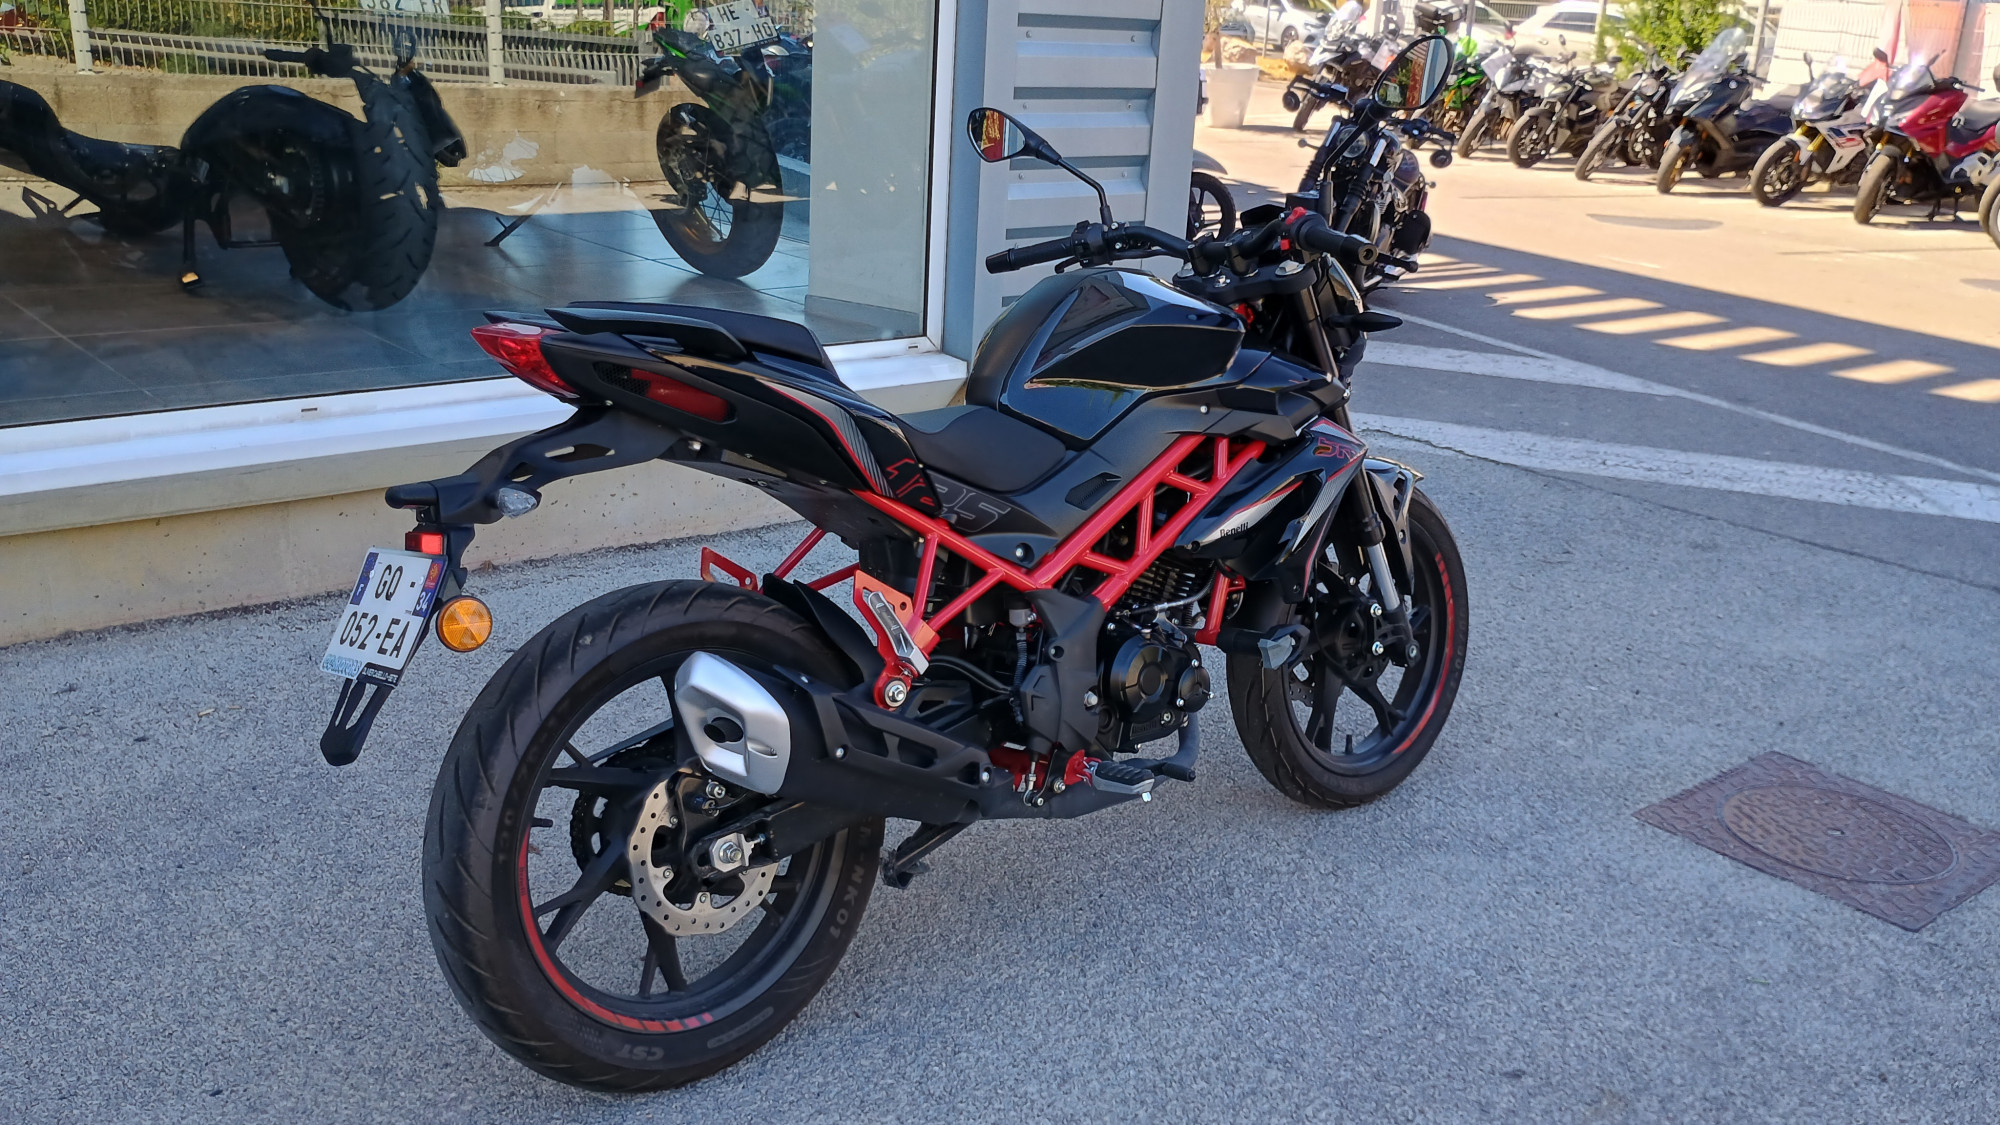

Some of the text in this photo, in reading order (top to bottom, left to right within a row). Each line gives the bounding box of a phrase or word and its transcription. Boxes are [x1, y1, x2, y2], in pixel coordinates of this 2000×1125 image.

[716, 4, 739, 24] HE
[1219, 522, 1249, 539] Benelli
[356, 584, 365, 597] F
[375, 563, 404, 602] GQ
[416, 591, 431, 612] 34
[339, 611, 410, 659] 052-EA
[615, 1044, 664, 1061] CST
